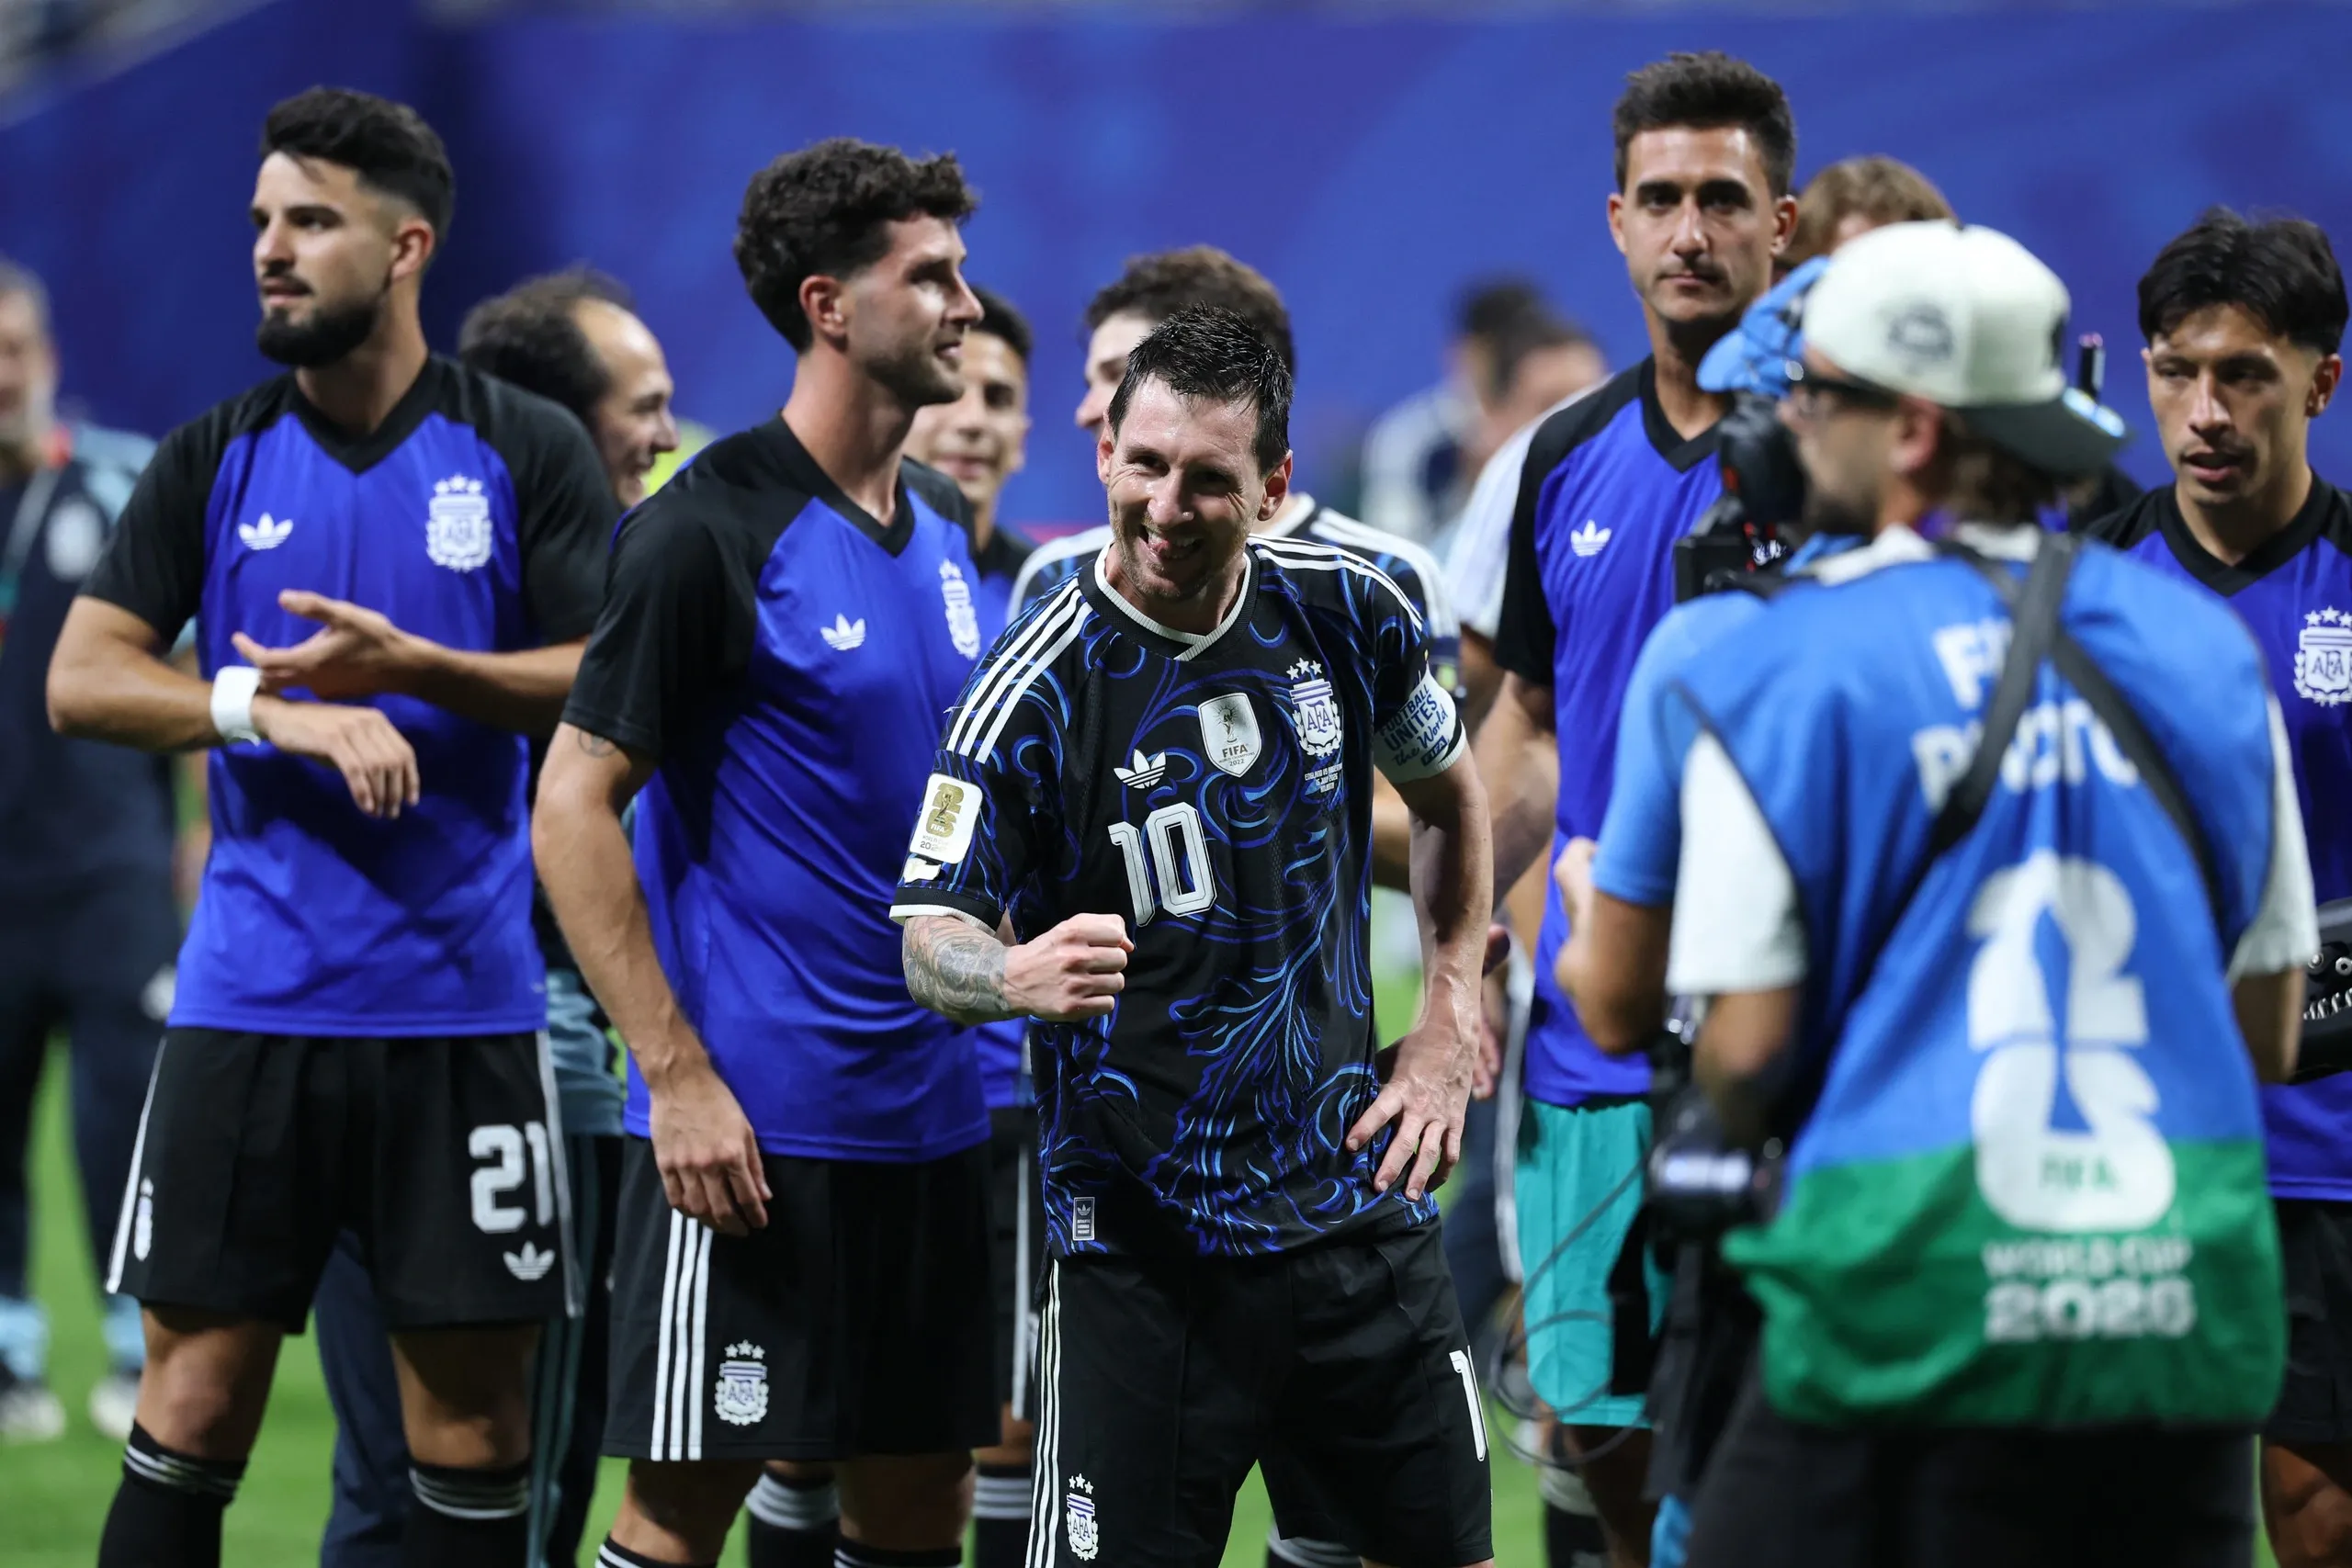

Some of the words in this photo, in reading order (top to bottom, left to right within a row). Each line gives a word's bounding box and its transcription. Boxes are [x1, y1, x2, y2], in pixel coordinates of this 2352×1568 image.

[1306, 700, 1332, 733] AFA
[1379, 683, 1429, 737] FOOTBALL
[1384, 694, 1438, 751] UNITES
[1392, 747, 1419, 766] the
[1417, 703, 1448, 750] World
[1222, 744, 1248, 758] FIFA
[1229, 759, 1245, 767] 2022
[931, 823, 945, 832] FIFA
[1107, 802, 1218, 928] 10
[469, 1121, 553, 1234] 21
[1449, 1345, 1489, 1462] 1
